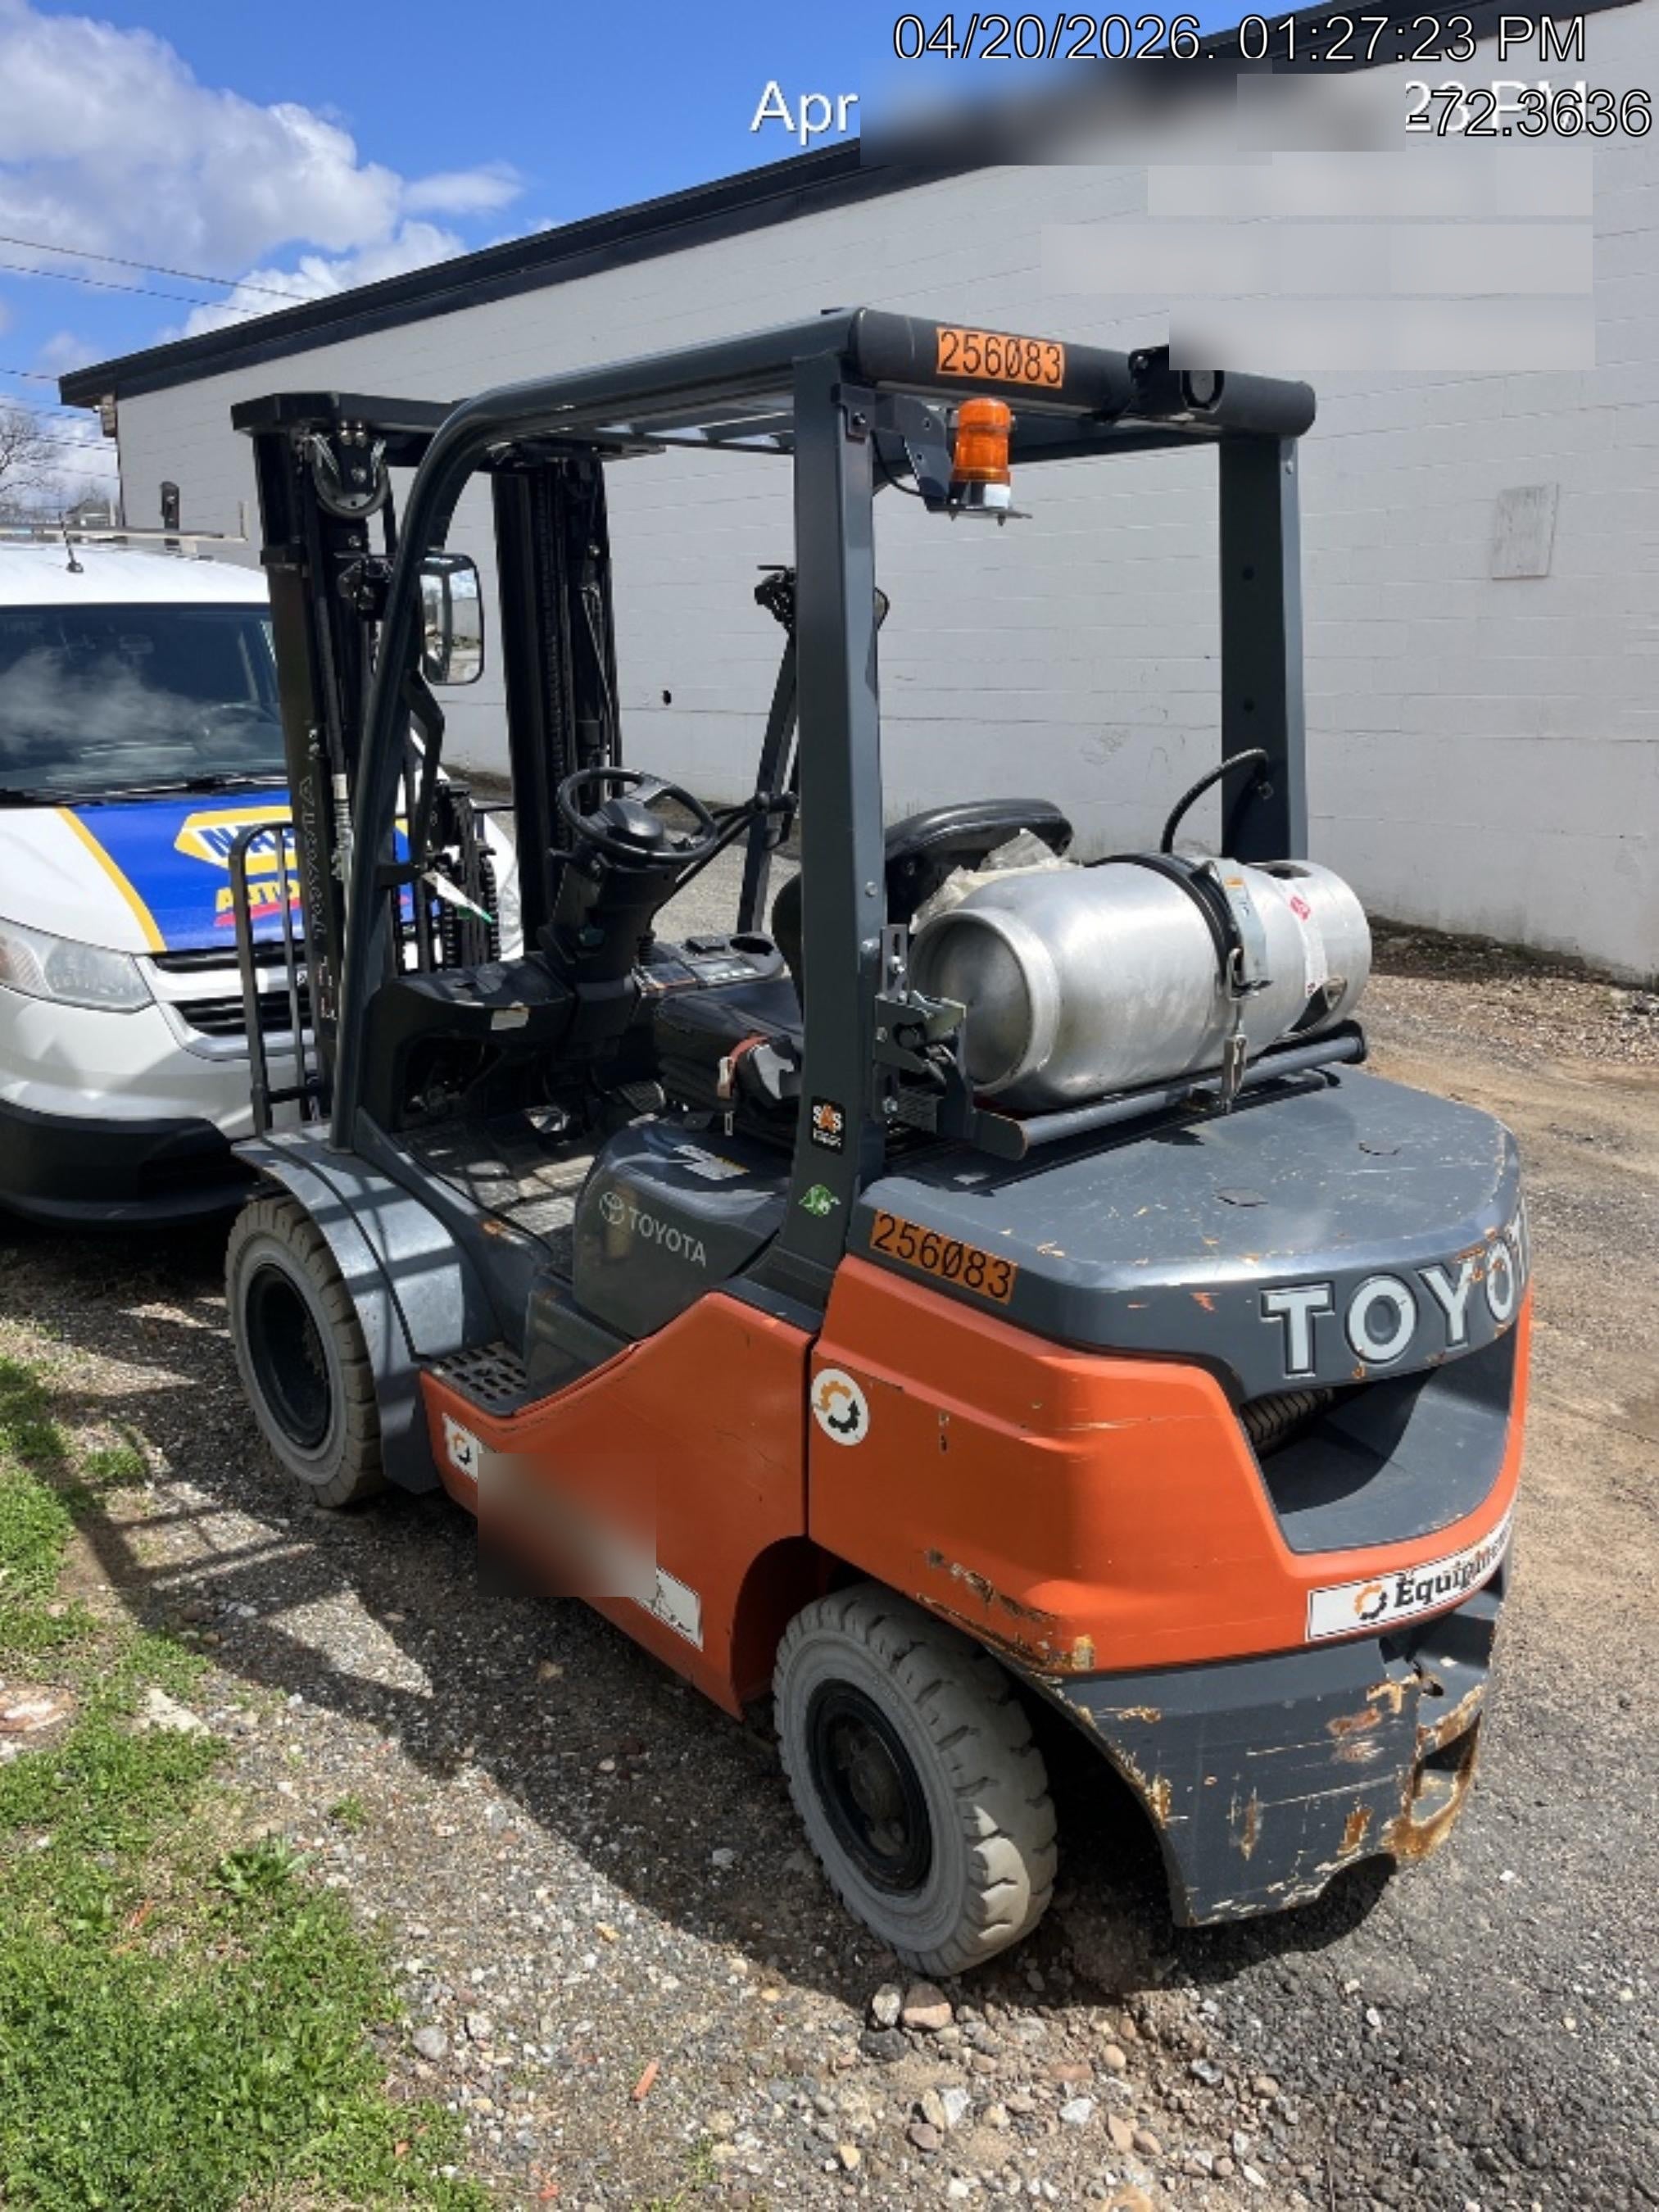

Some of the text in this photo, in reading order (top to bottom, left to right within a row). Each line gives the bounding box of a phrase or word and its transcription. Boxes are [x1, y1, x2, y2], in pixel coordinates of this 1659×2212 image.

[940, 330, 1061, 384] 256083
[628, 1205, 707, 1269] TOYOTA
[873, 1213, 1012, 1299] 256083
